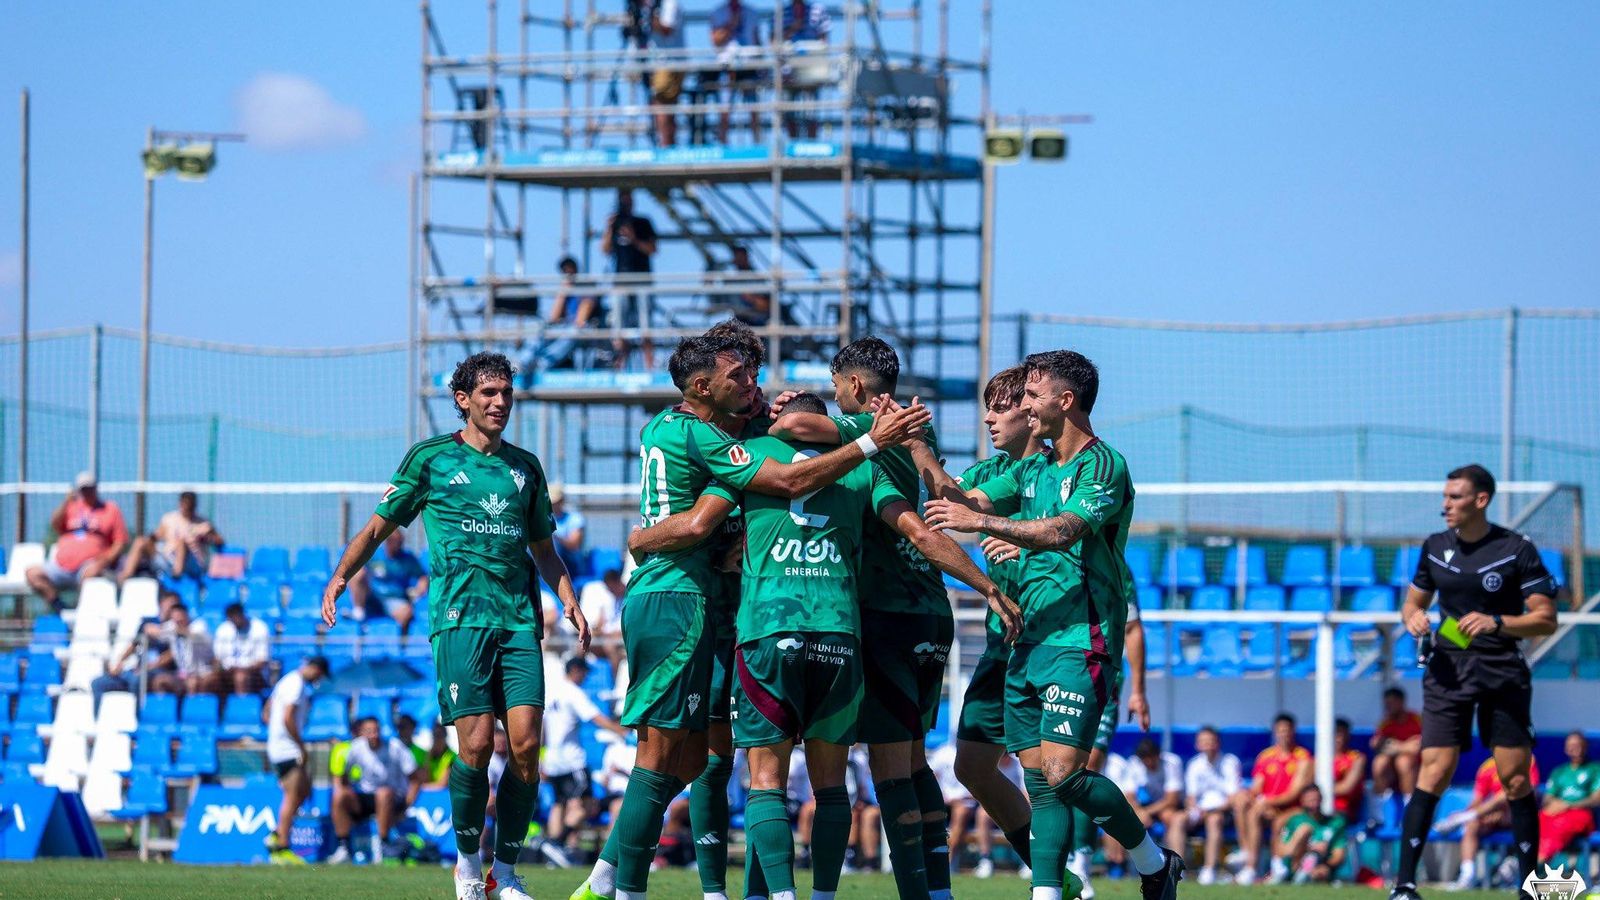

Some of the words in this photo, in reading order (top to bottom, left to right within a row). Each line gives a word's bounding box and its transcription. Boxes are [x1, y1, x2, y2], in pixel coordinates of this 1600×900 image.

[1079, 499, 1104, 521] MGS
[785, 566, 830, 577] ENERGÍA
[818, 644, 831, 653] UN
[816, 654, 828, 663] TU
